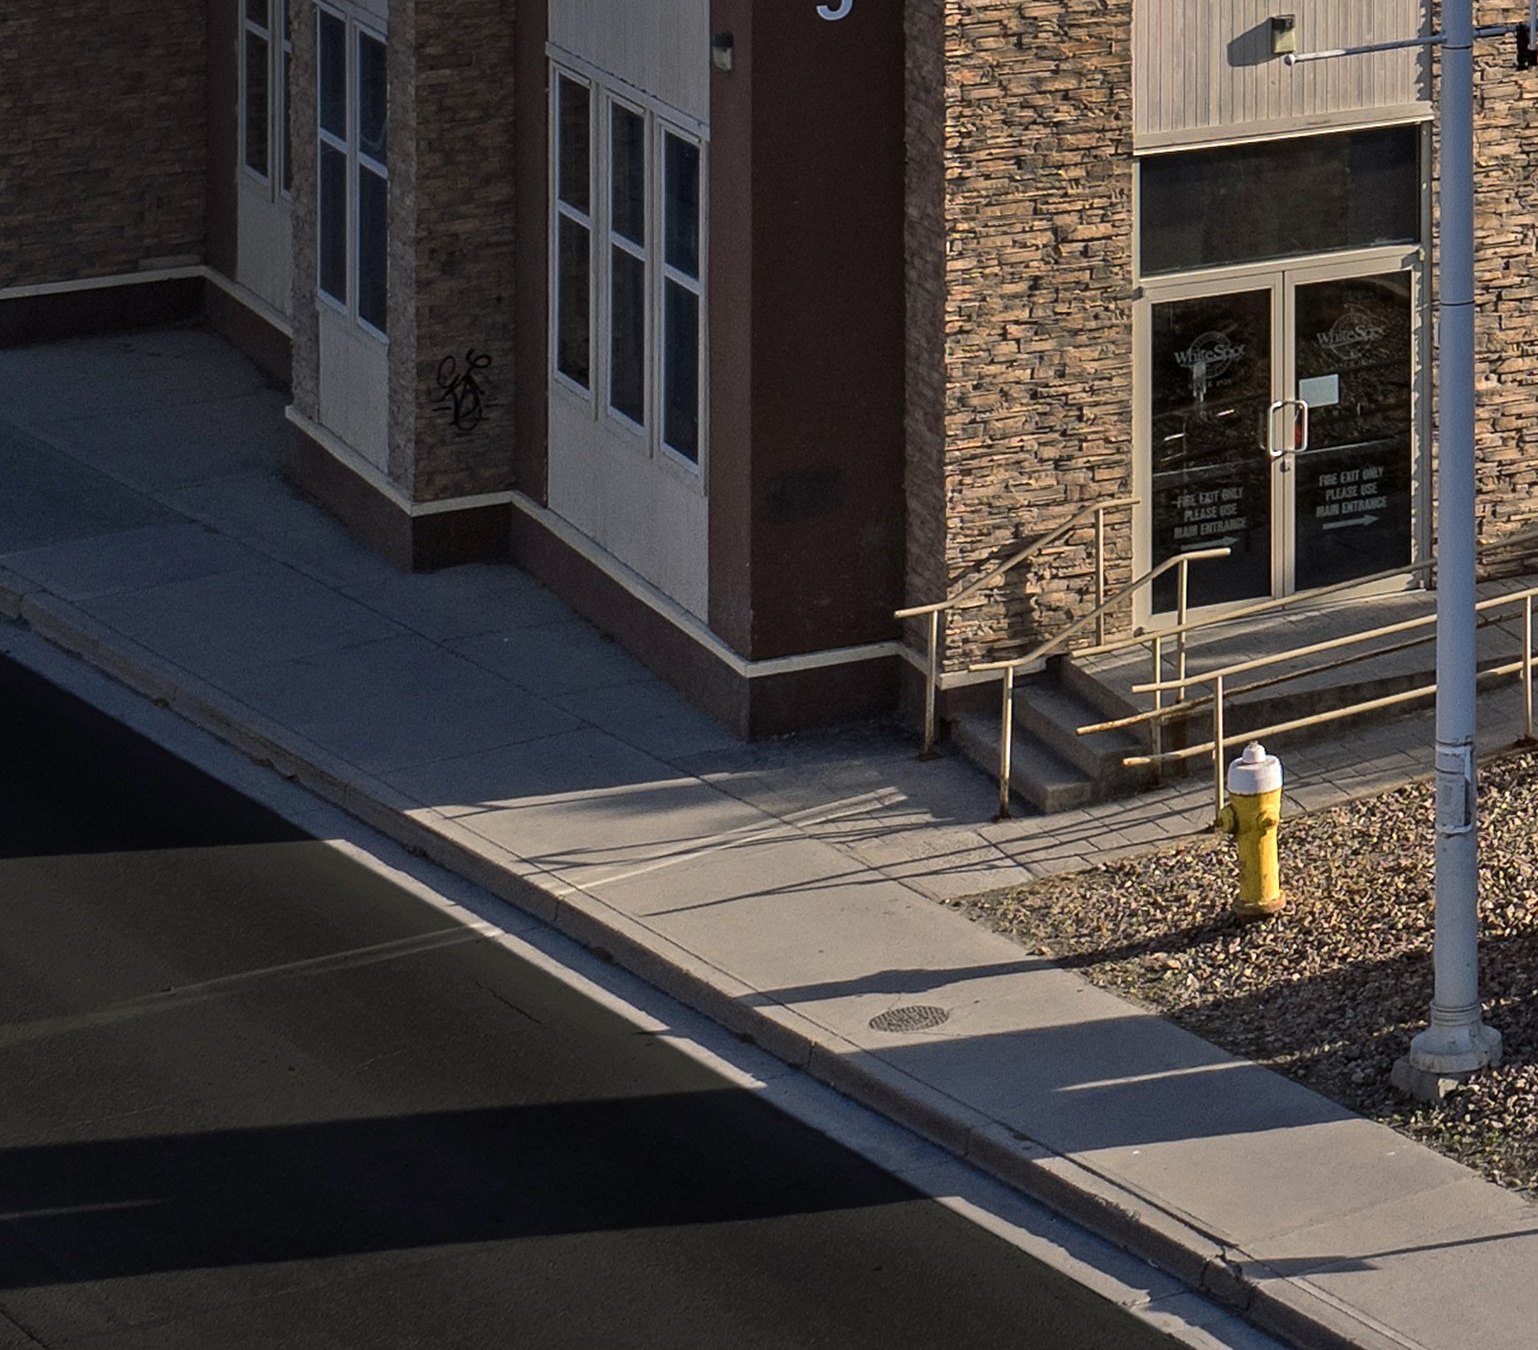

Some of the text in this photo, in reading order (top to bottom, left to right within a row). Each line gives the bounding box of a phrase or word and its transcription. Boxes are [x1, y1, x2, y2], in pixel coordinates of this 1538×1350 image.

[1318, 467, 1384, 487] FIRE EXIT ONLY
[1177, 487, 1244, 508] FIRE EXIT ONLY
[1326, 482, 1379, 501] PLEASE USE
[1184, 503, 1238, 522] PLEASE USE
[1316, 496, 1388, 518] MAIN ENTRANCE
[1173, 517, 1248, 539] MAIN ENTRANCE
